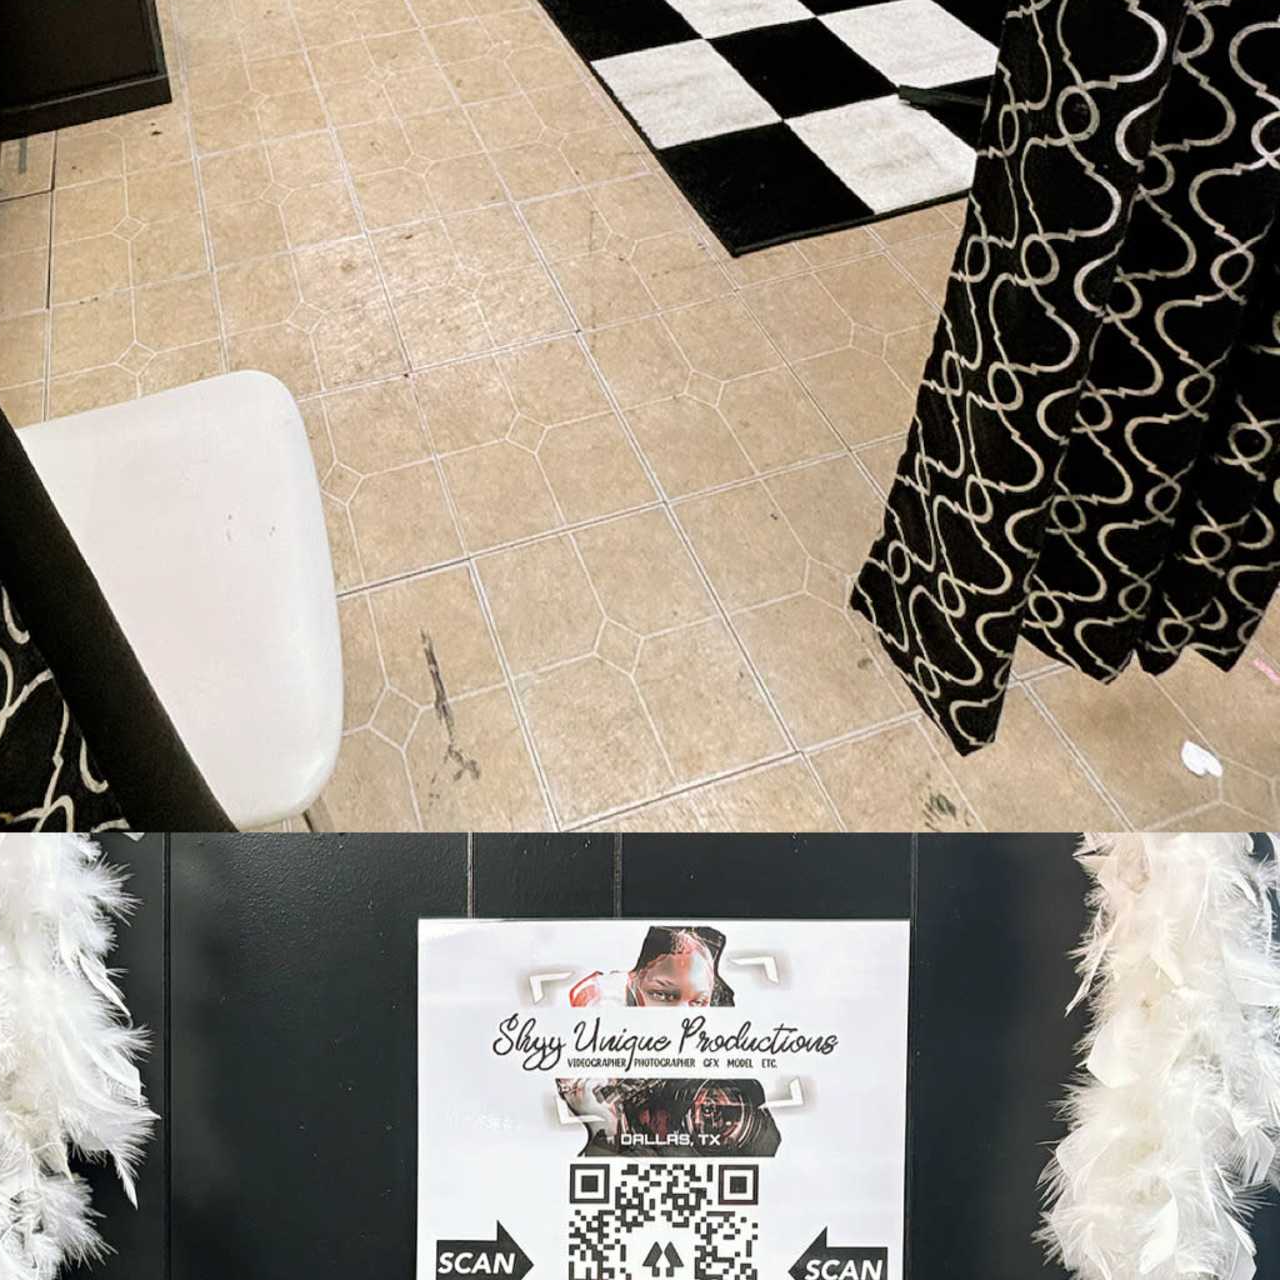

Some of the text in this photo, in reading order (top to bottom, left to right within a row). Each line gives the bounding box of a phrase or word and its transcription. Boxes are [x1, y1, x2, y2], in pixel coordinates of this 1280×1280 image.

[493, 1014, 838, 1072] Shyy Unique Productions
[633, 1058, 696, 1068] PHOTOGRAPHER
[727, 1058, 753, 1069] MODEL
[621, 1133, 721, 1146] DALLAS, TX
[438, 1252, 515, 1275] SCAN
